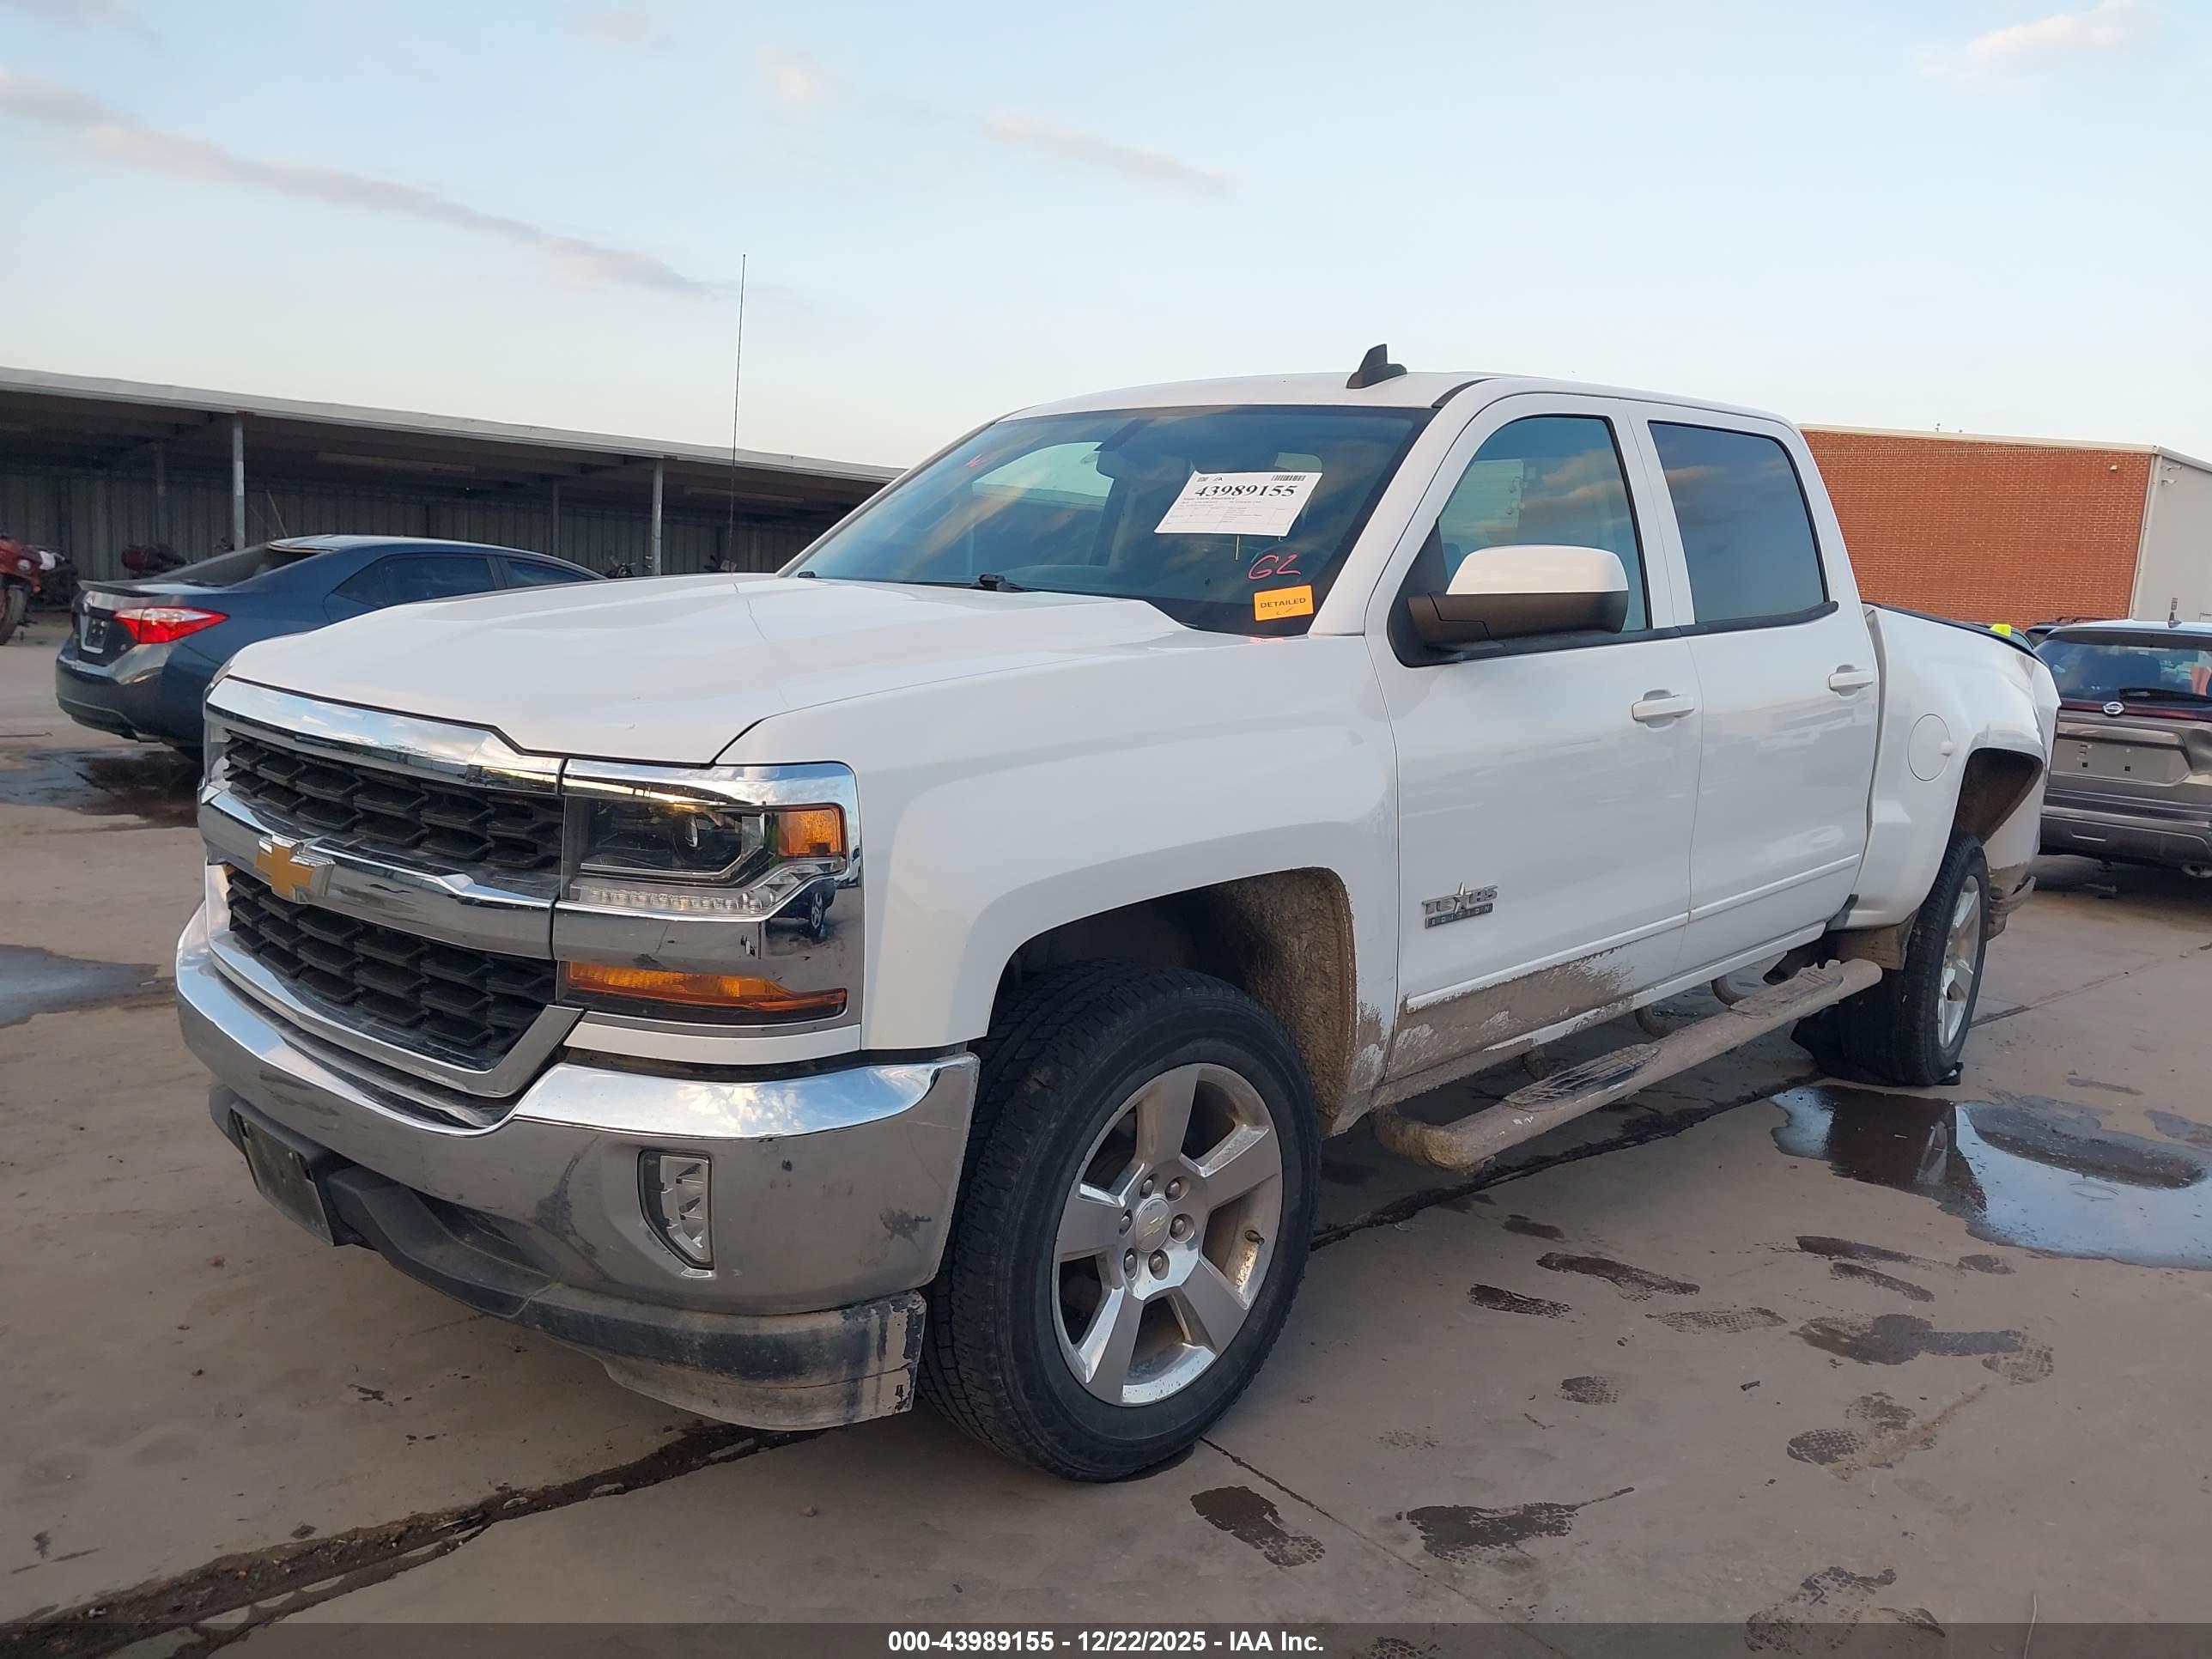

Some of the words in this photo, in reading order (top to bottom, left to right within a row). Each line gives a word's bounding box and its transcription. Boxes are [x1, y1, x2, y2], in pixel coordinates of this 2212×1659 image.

[1194, 485, 1298, 497] 43989155
[1260, 597, 1306, 609] DETAILED
[1421, 881, 1498, 915] TEXAS
